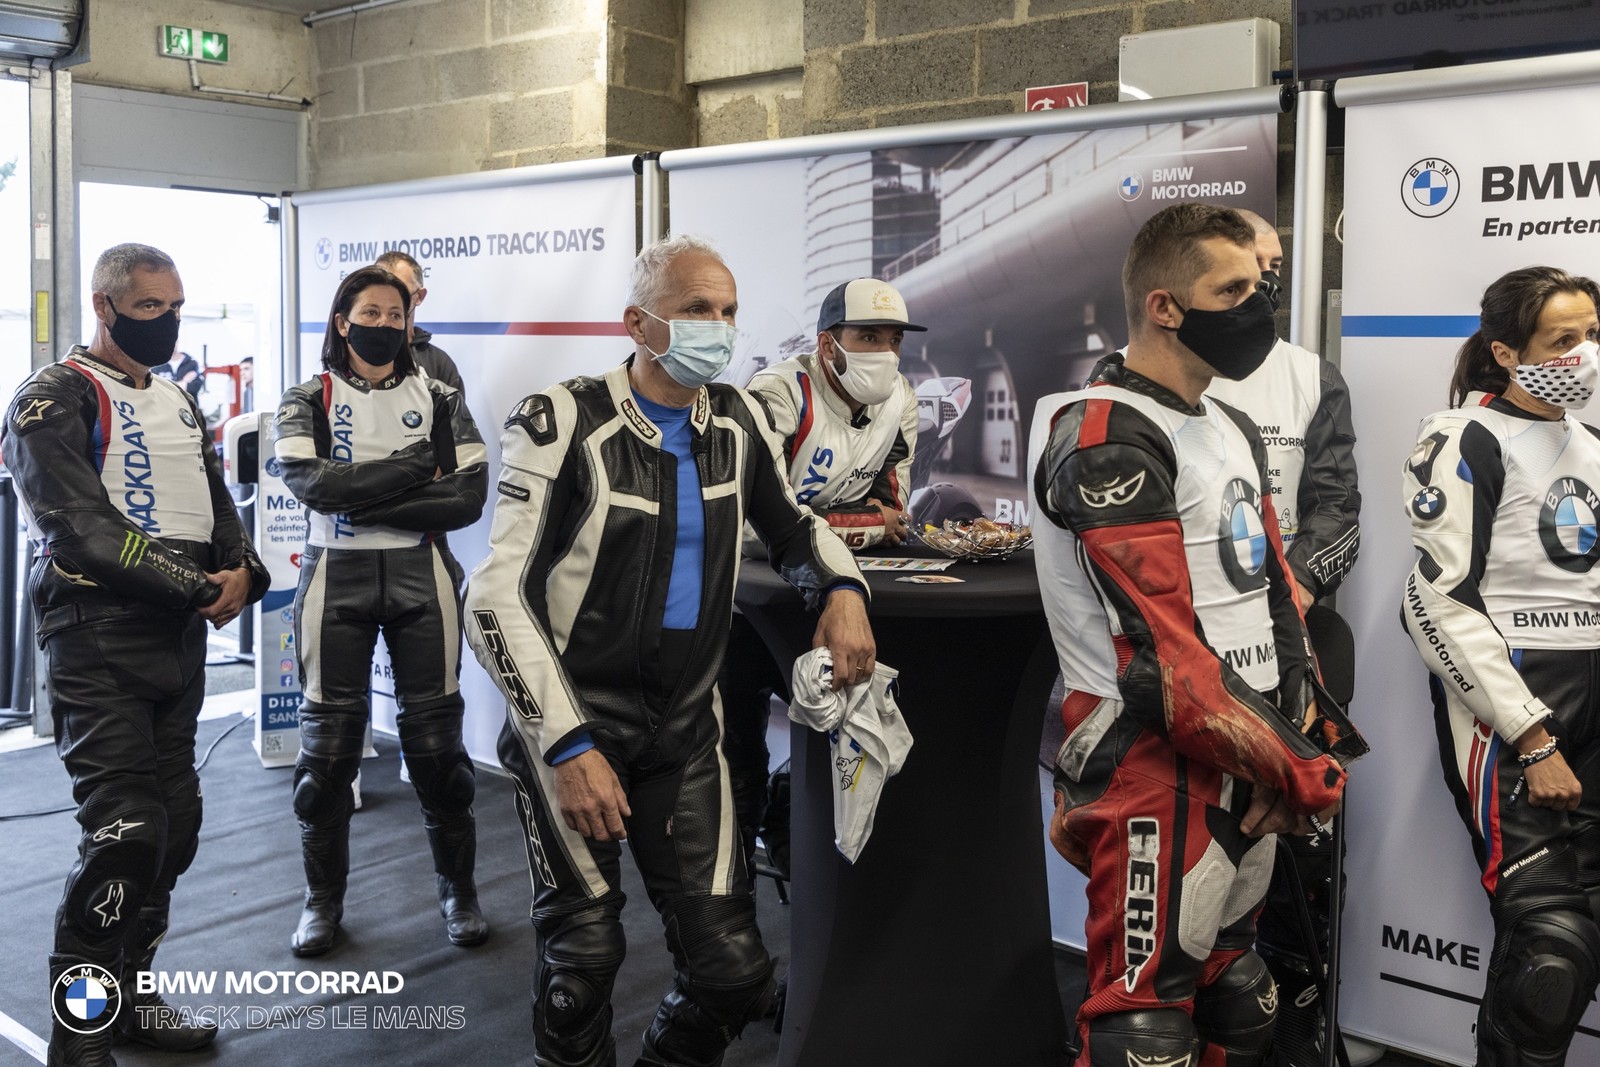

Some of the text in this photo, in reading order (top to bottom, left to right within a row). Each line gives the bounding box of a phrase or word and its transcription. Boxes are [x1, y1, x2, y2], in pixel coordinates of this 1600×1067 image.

[1152, 167, 1193, 183] BMW
[1481, 160, 1600, 203] BMW
[1151, 181, 1247, 200] MOTORRAD
[1482, 217, 1513, 237] En
[339, 227, 605, 262] BMW MOTORRAD TRACK DAYS
[1543, 357, 1579, 367] MOTUL
[1258, 425, 1281, 435] MW
[274, 514, 288, 522] de
[1513, 612, 1569, 628] BMW
[1407, 573, 1475, 693] BMW Motorrad
[1502, 847, 1550, 879] BMW Motorrad
[1381, 925, 1480, 971] MAKE
